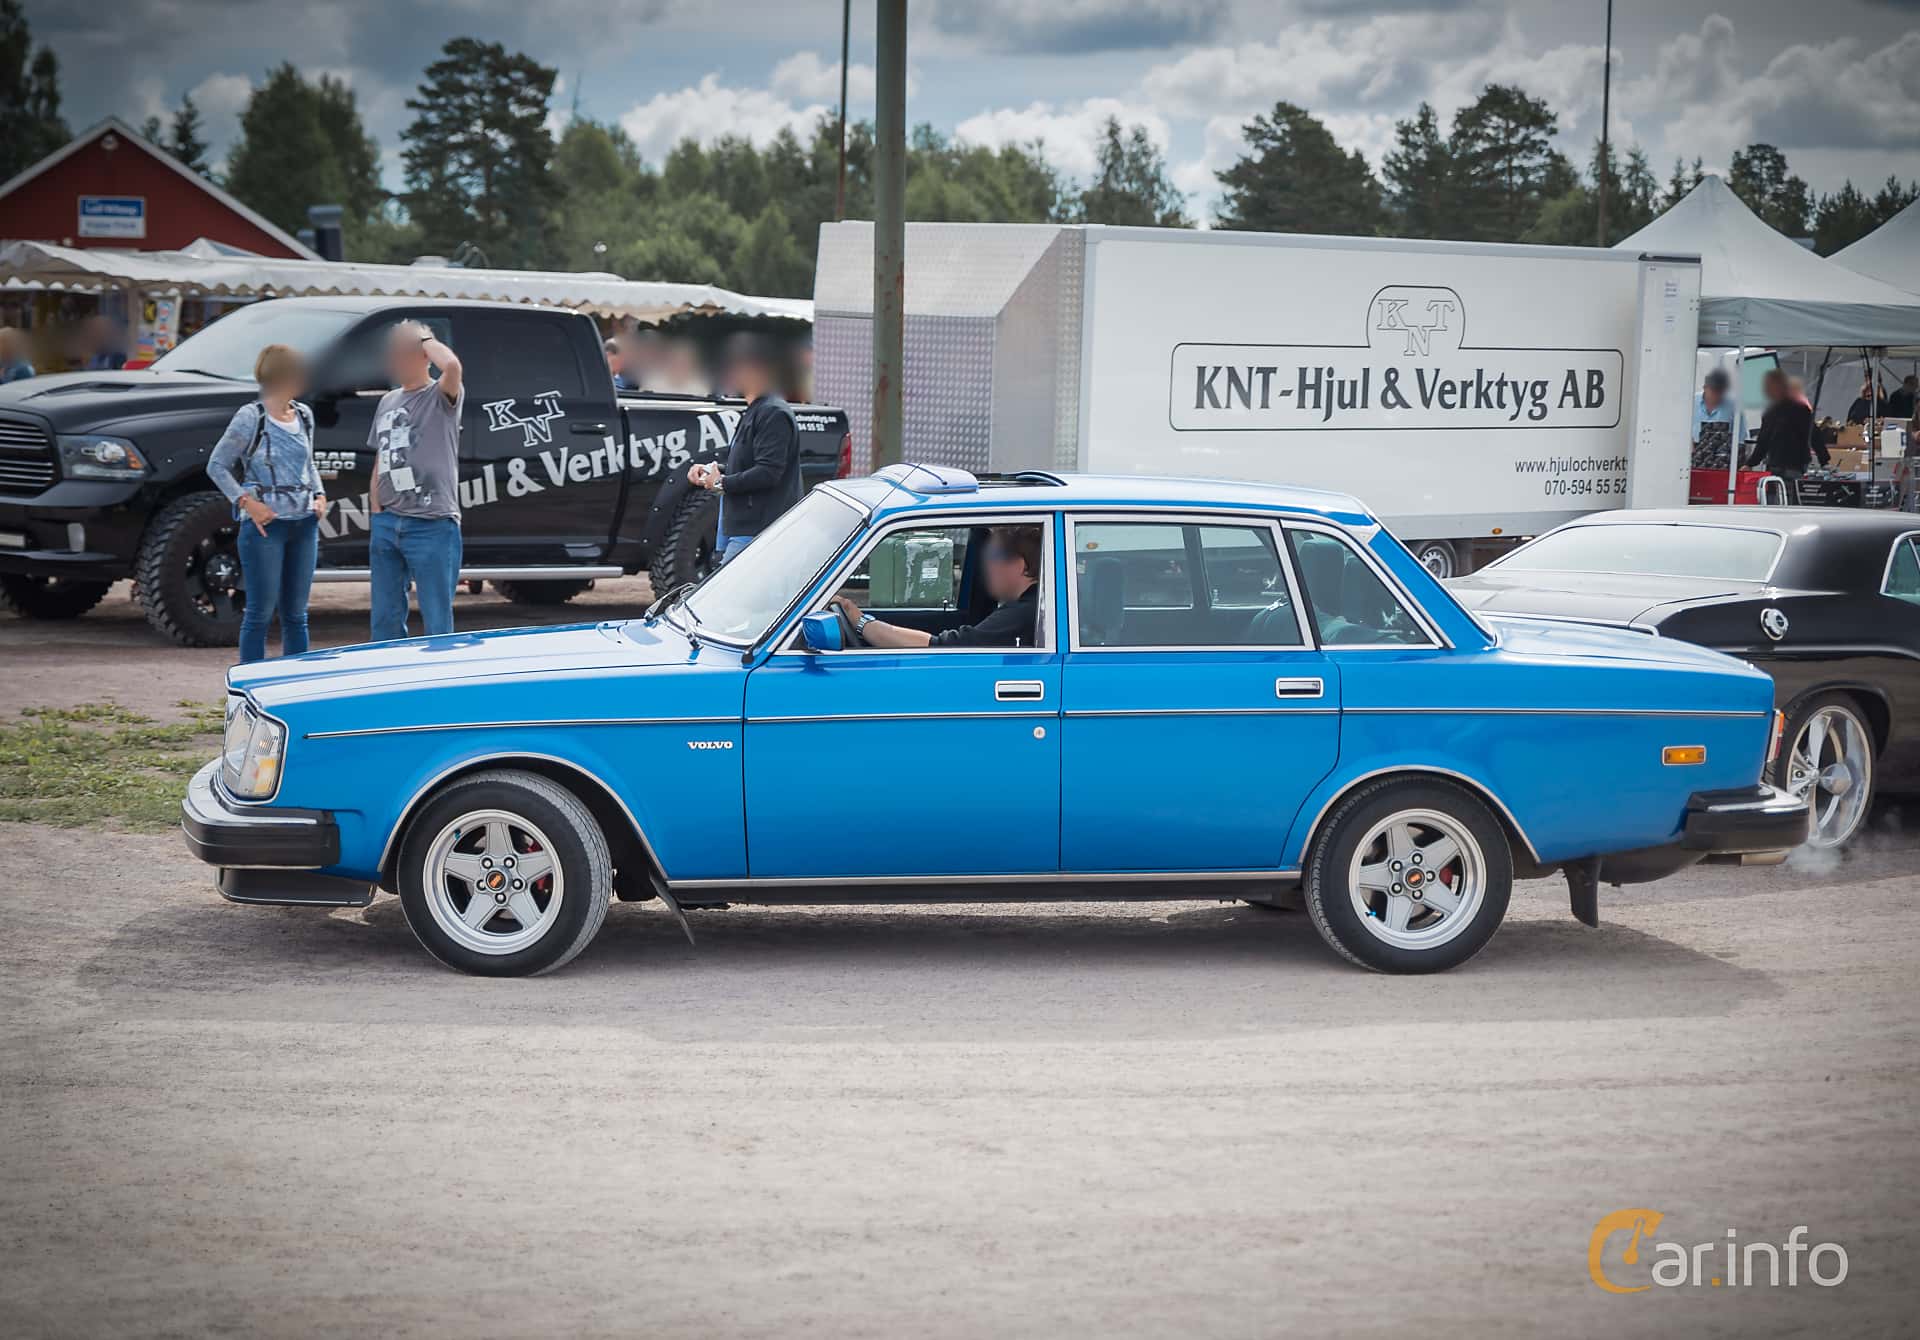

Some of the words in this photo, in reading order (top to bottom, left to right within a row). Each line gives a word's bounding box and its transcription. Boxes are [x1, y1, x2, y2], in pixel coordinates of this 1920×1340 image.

[483, 390, 566, 447] KNT
[1195, 366, 1370, 422] KNT-Hjul
[1381, 367, 1413, 409] &
[1415, 368, 1550, 421] Verktyg
[1557, 369, 1605, 409] AB
[506, 458, 546, 498] &
[539, 429, 691, 487] Verktyg
[1544, 479, 1592, 495] 070-594
[1596, 478, 1610, 494] 55
[1613, 478, 1627, 494] 52
[687, 741, 734, 750] VOLVO
